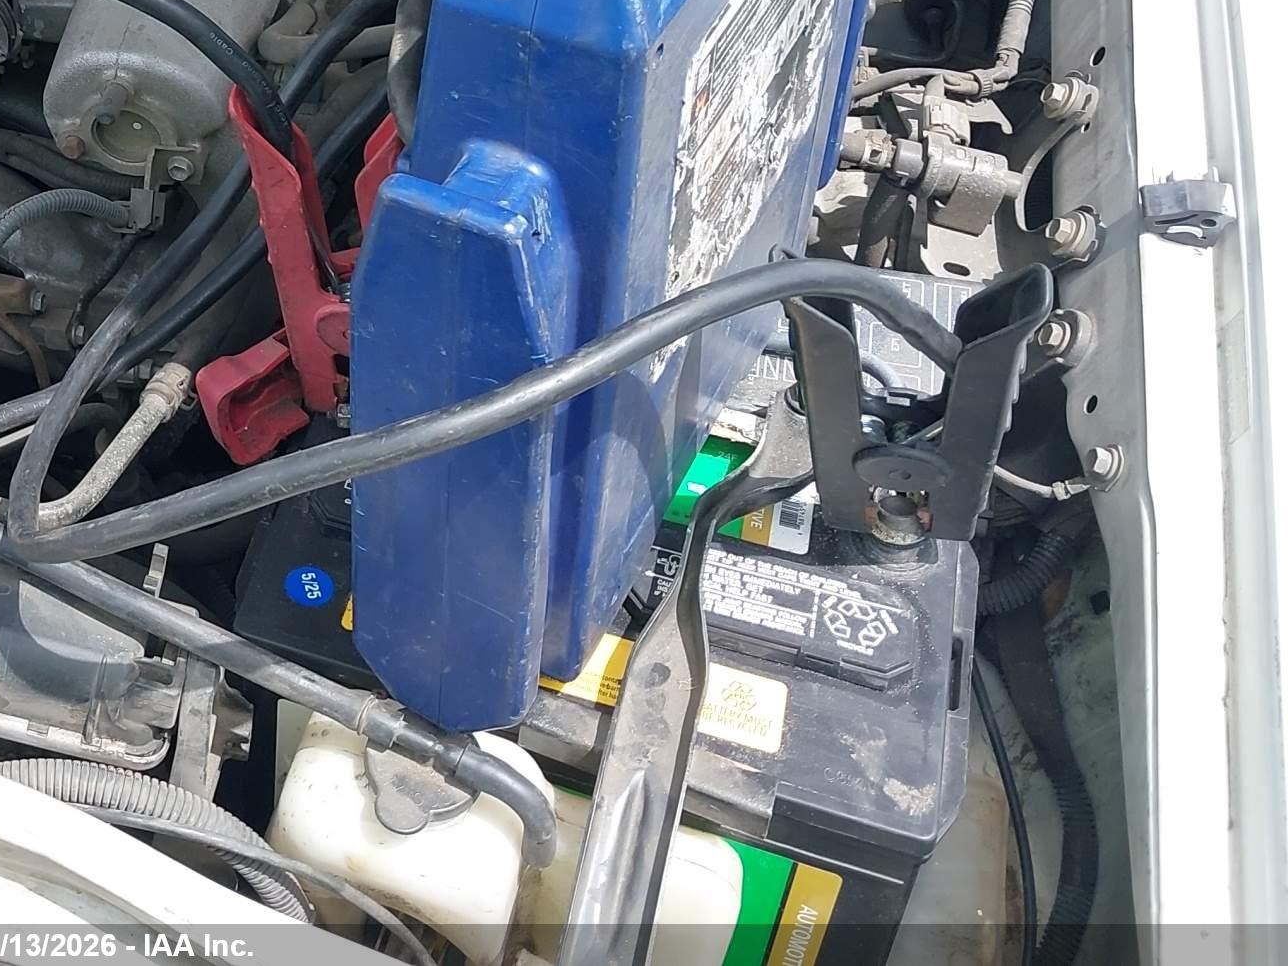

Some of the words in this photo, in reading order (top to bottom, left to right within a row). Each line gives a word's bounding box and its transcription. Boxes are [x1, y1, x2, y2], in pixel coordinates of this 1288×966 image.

[300, 572, 323, 600] 5/25
[724, 585, 749, 598] HELP
[749, 592, 773, 604] FAST
